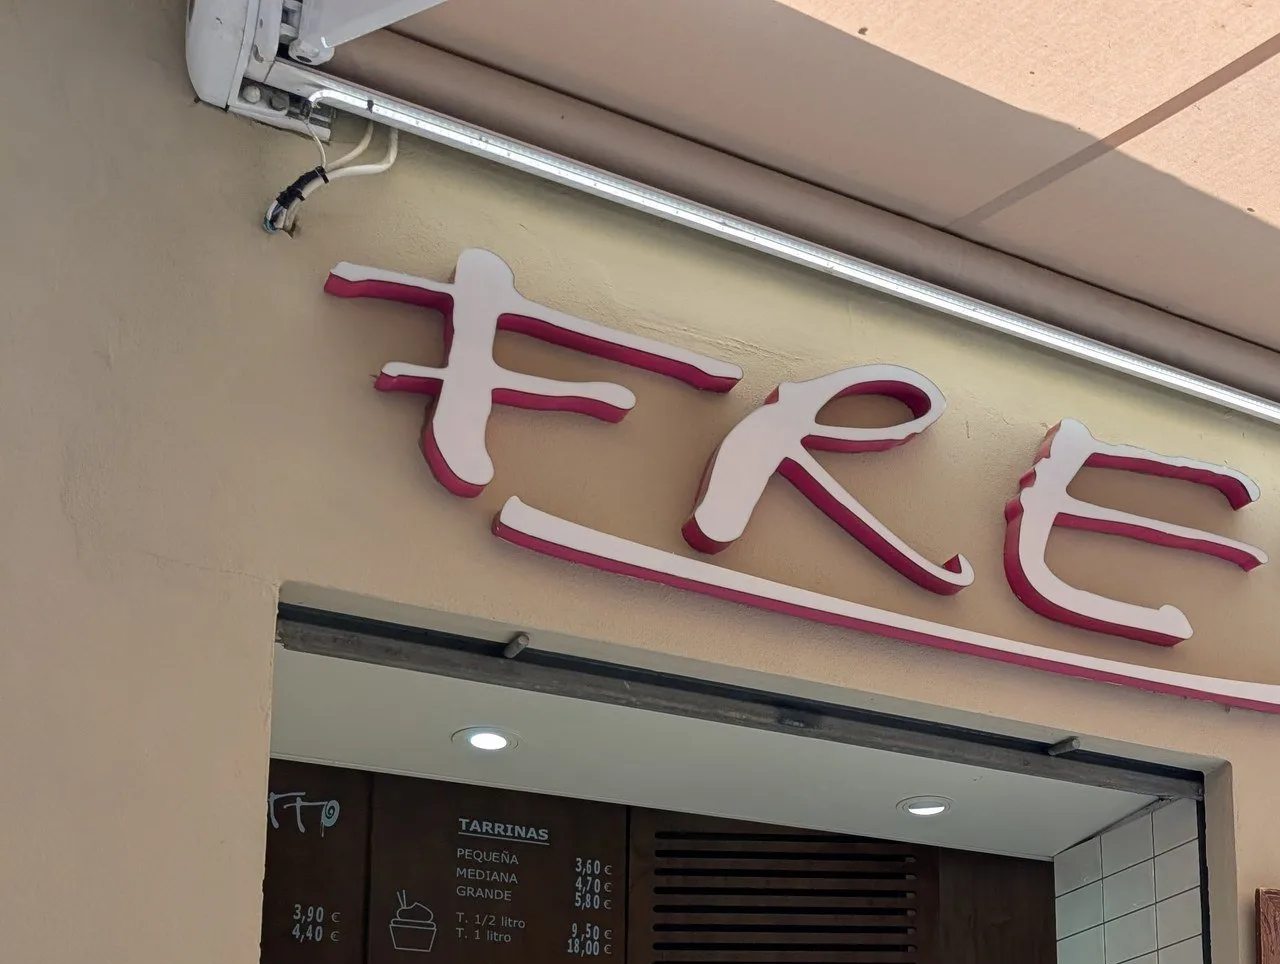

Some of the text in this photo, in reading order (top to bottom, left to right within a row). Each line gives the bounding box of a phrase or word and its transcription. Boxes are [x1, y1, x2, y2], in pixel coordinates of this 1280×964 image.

[459, 818, 549, 841] TARRINAS
[456, 848, 519, 865] PEQUEÑA
[575, 858, 601, 875] 3,60
[456, 867, 518, 884] MEDIANA
[456, 886, 512, 901] GRANDE
[575, 877, 601, 893] 4,70
[575, 893, 601, 910] 5,80
[293, 904, 324, 923] 3,90
[456, 912, 526, 930] T. 1/2 litro
[292, 924, 323, 943] 4,40
[455, 928, 512, 943] T. 1 litro
[567, 940, 600, 956] 18,00
